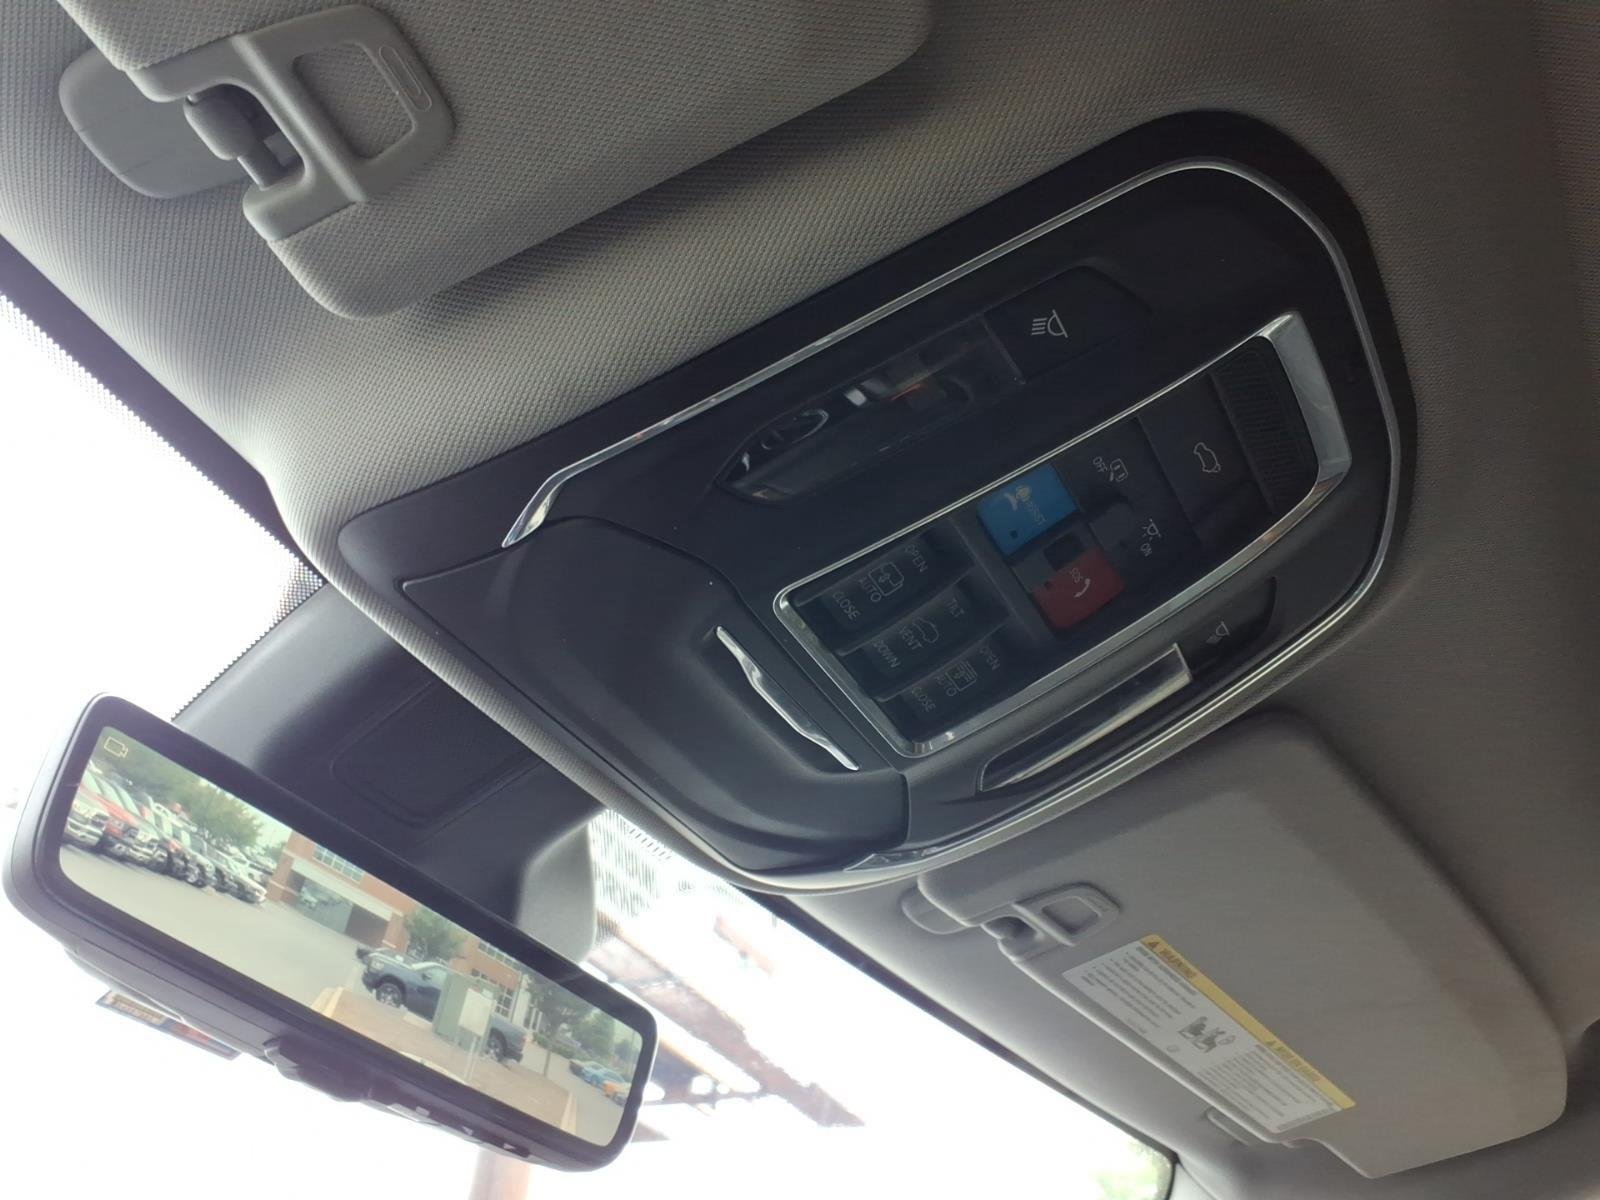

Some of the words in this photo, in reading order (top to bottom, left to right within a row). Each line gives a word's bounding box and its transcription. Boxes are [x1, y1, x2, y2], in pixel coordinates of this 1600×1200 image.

[1091, 455, 1108, 474] OFF
[904, 544, 929, 573] OPEN
[1139, 541, 1154, 557] ON
[1067, 566, 1085, 585] SOS
[858, 576, 882, 604] AUTO
[831, 589, 861, 621] CLOSE
[945, 597, 965, 619] TILT
[898, 625, 922, 652] VENT
[872, 637, 900, 669] DOWN
[978, 645, 1002, 671] OPEN
[934, 672, 958, 698] AUTO
[910, 685, 937, 713] CLOSE
